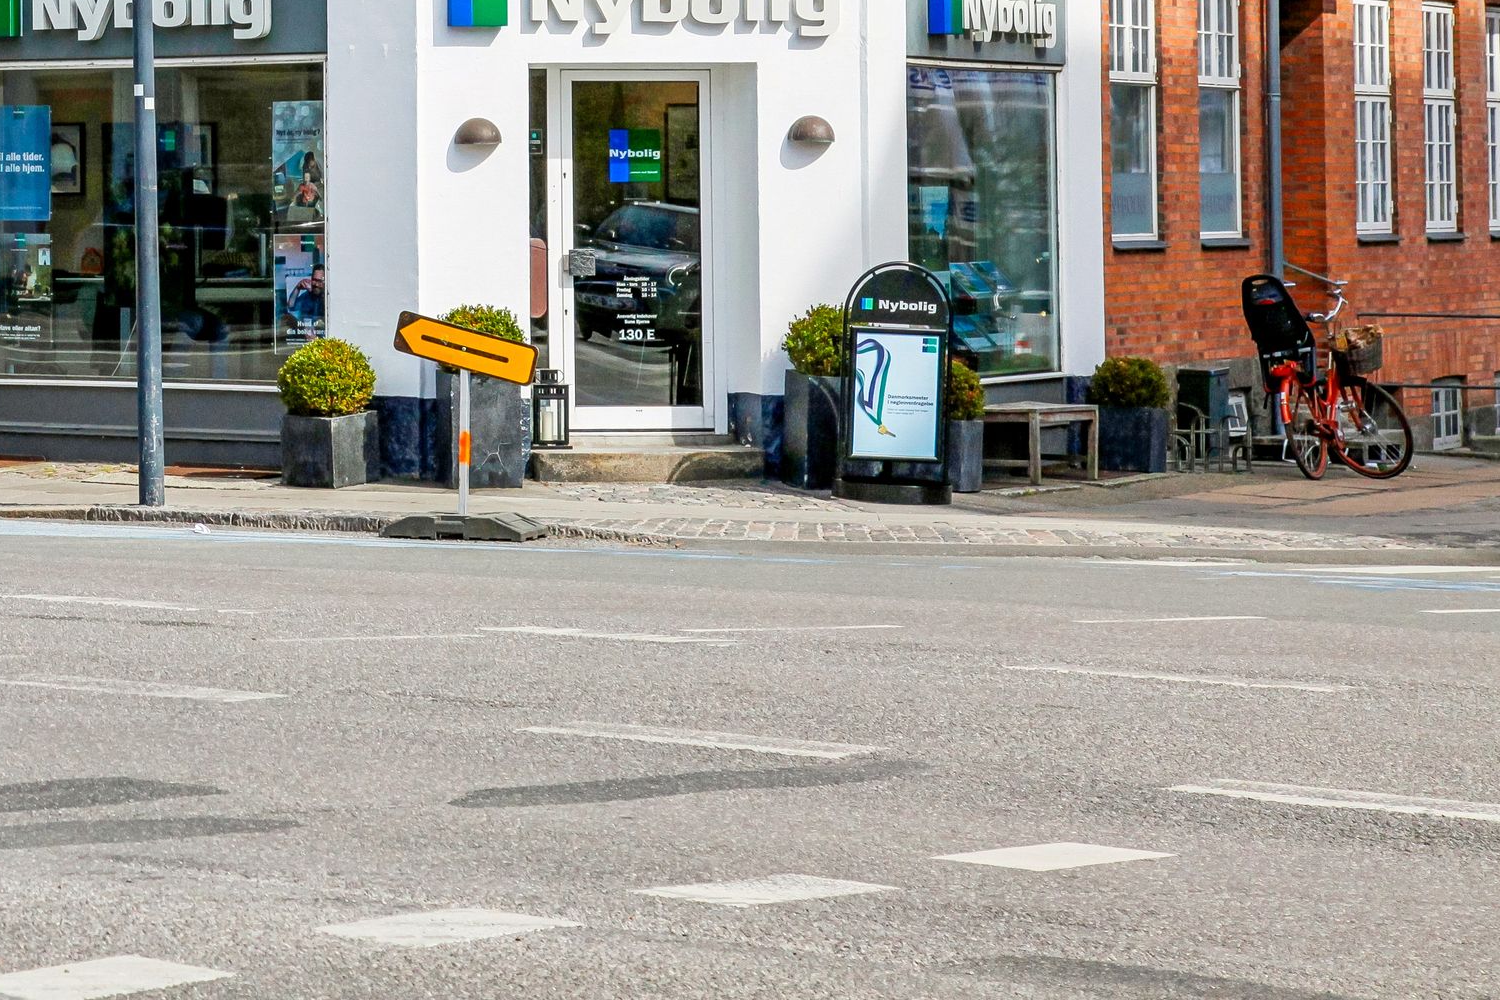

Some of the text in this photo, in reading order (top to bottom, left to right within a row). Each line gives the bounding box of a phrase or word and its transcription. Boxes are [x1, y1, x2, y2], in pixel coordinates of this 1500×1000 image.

[6, 152, 21, 161] alle
[22, 152, 44, 161] tider.
[609, 148, 660, 159] Nybolig
[5, 163, 20, 173] alle
[22, 163, 45, 174] hjem.
[878, 299, 937, 314] Nybolig
[618, 329, 656, 340] 130 E
